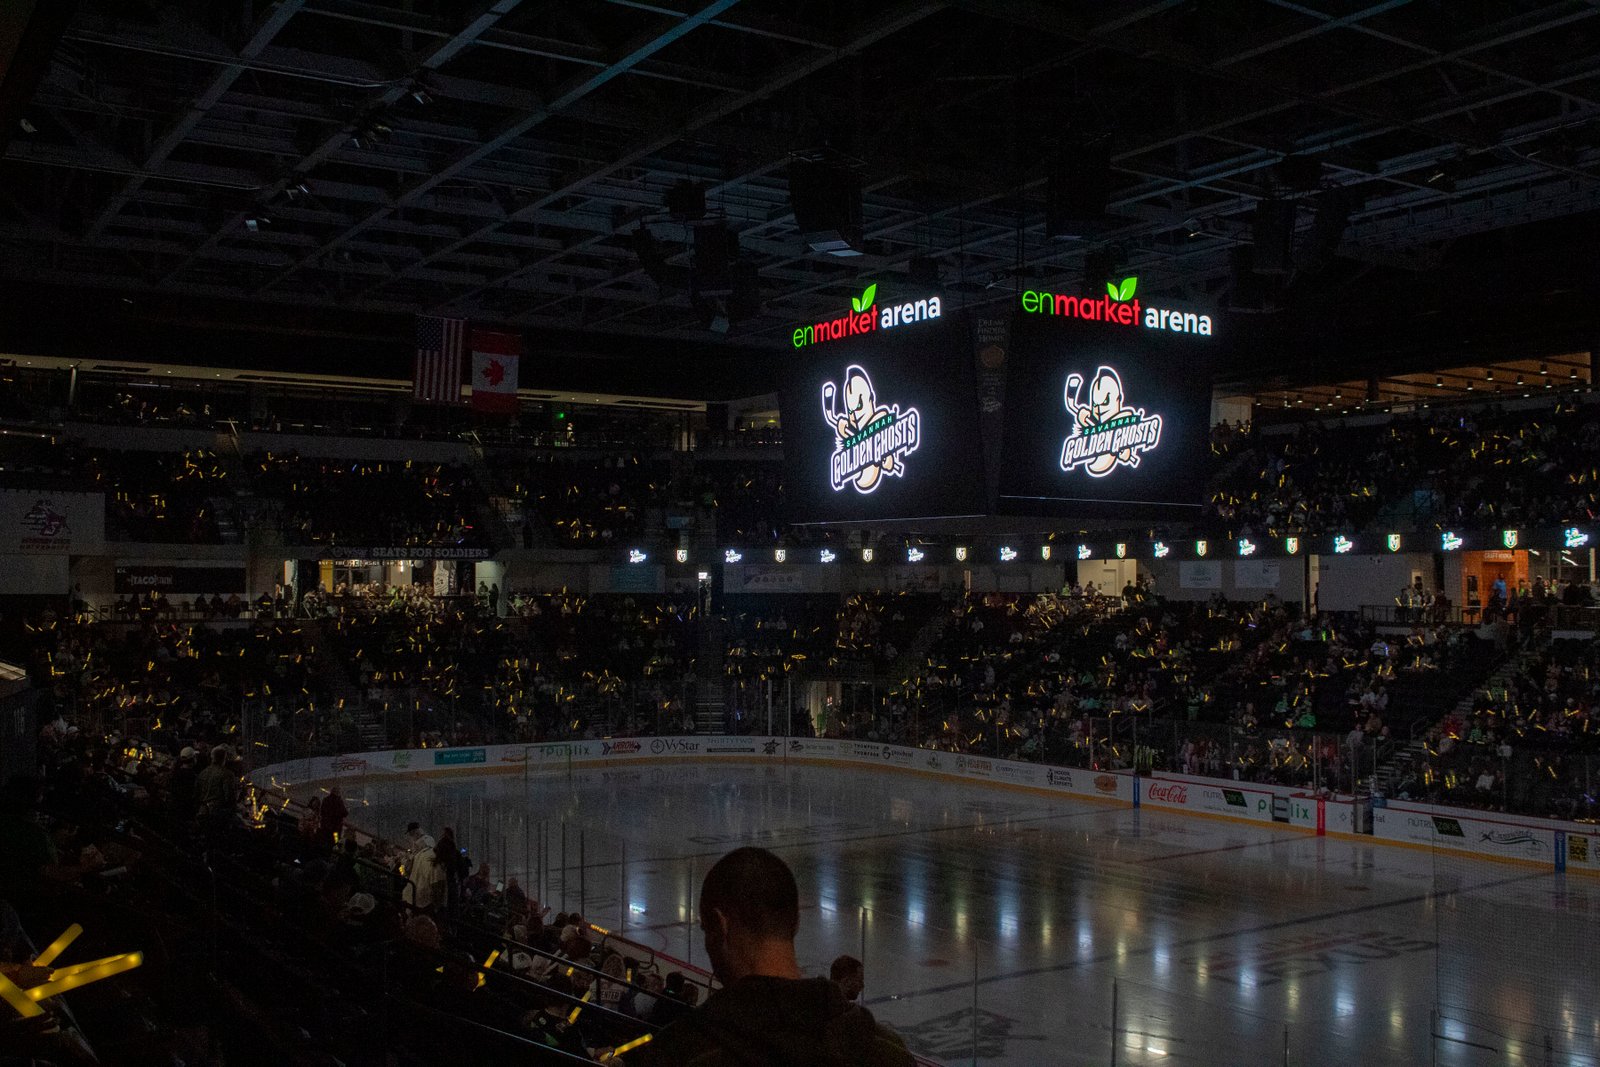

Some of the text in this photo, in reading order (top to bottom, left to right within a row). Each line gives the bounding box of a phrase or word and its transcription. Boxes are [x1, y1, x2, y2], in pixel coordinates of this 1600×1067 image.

[792, 296, 942, 348] enmarket arena
[1021, 290, 1212, 336] enmarket arena
[846, 415, 892, 448] SAVANNAH
[1064, 417, 1158, 465] GOLDEN GHOSTS
[1084, 416, 1137, 435] SAVANNAH
[833, 412, 916, 484] GOLDEN GHOSTS
[371, 547, 489, 558] SEATS FOR SOLDIERS
[664, 738, 701, 753] VyStar
[1257, 799, 1309, 820] Pulix
